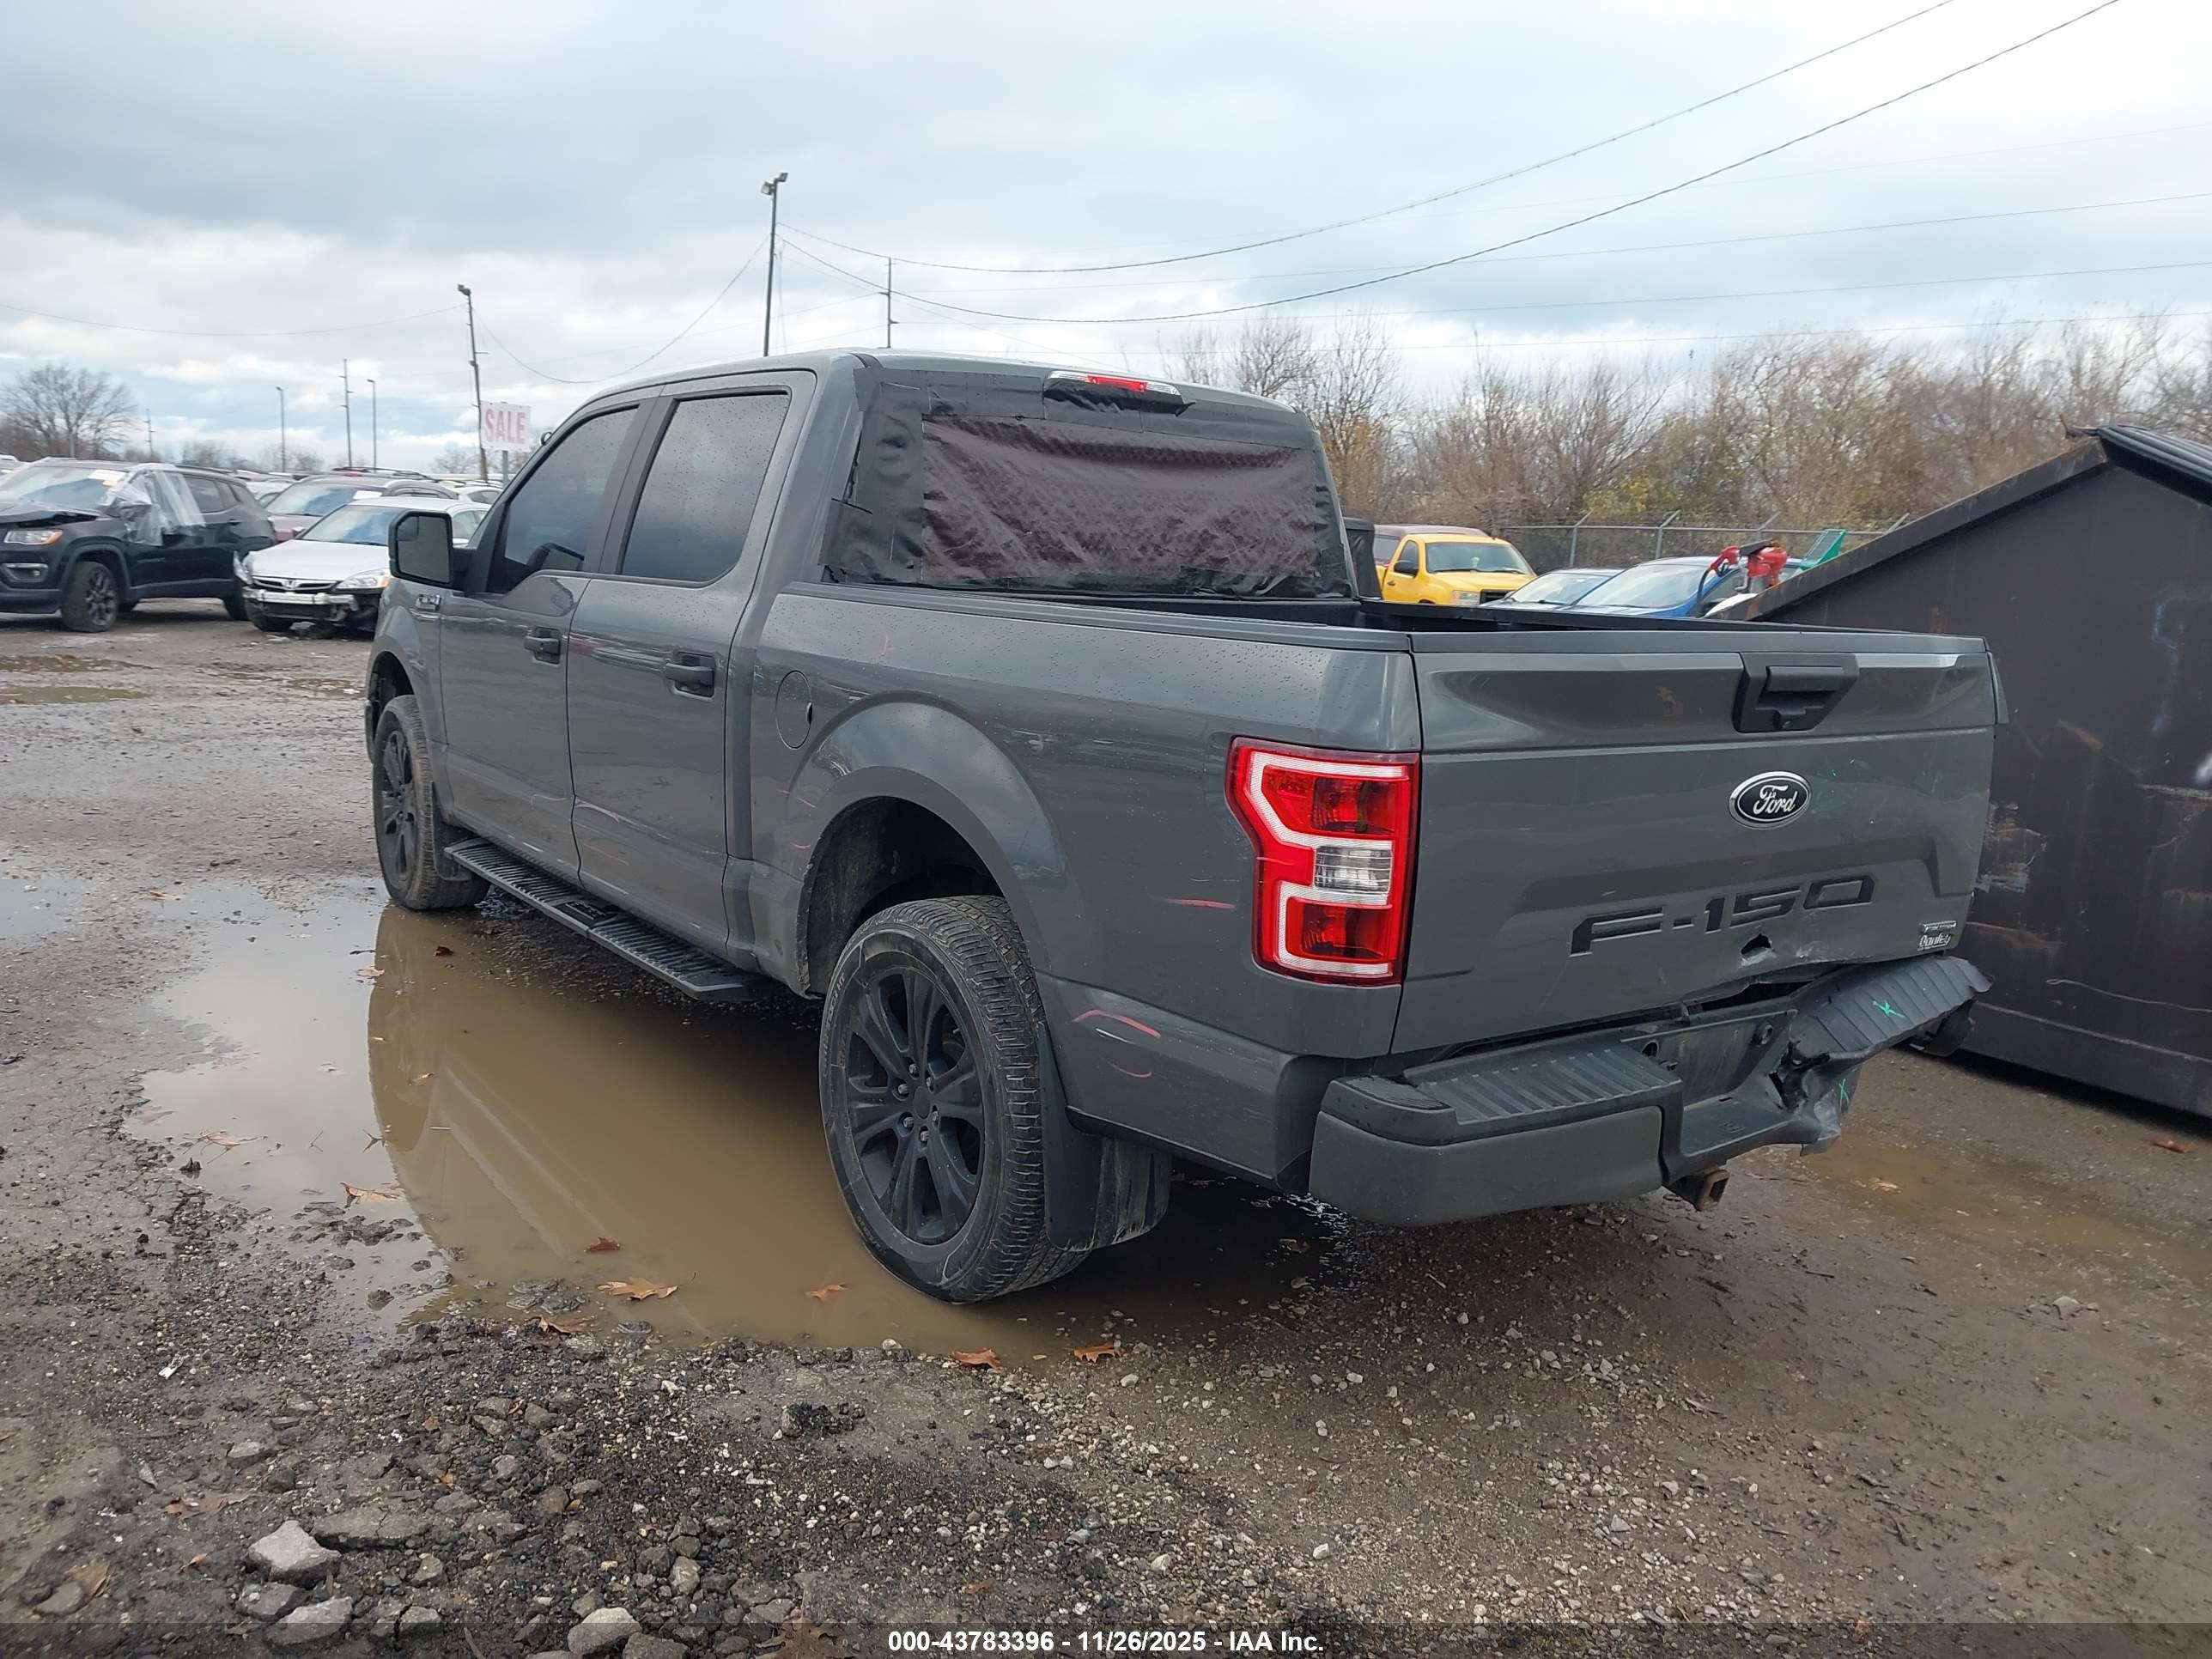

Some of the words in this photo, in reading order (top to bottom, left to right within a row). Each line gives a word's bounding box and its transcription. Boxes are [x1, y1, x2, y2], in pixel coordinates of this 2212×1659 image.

[484, 409, 526, 444] SALE
[1753, 784, 1798, 815] Ford
[1569, 874, 1875, 957] F-150
